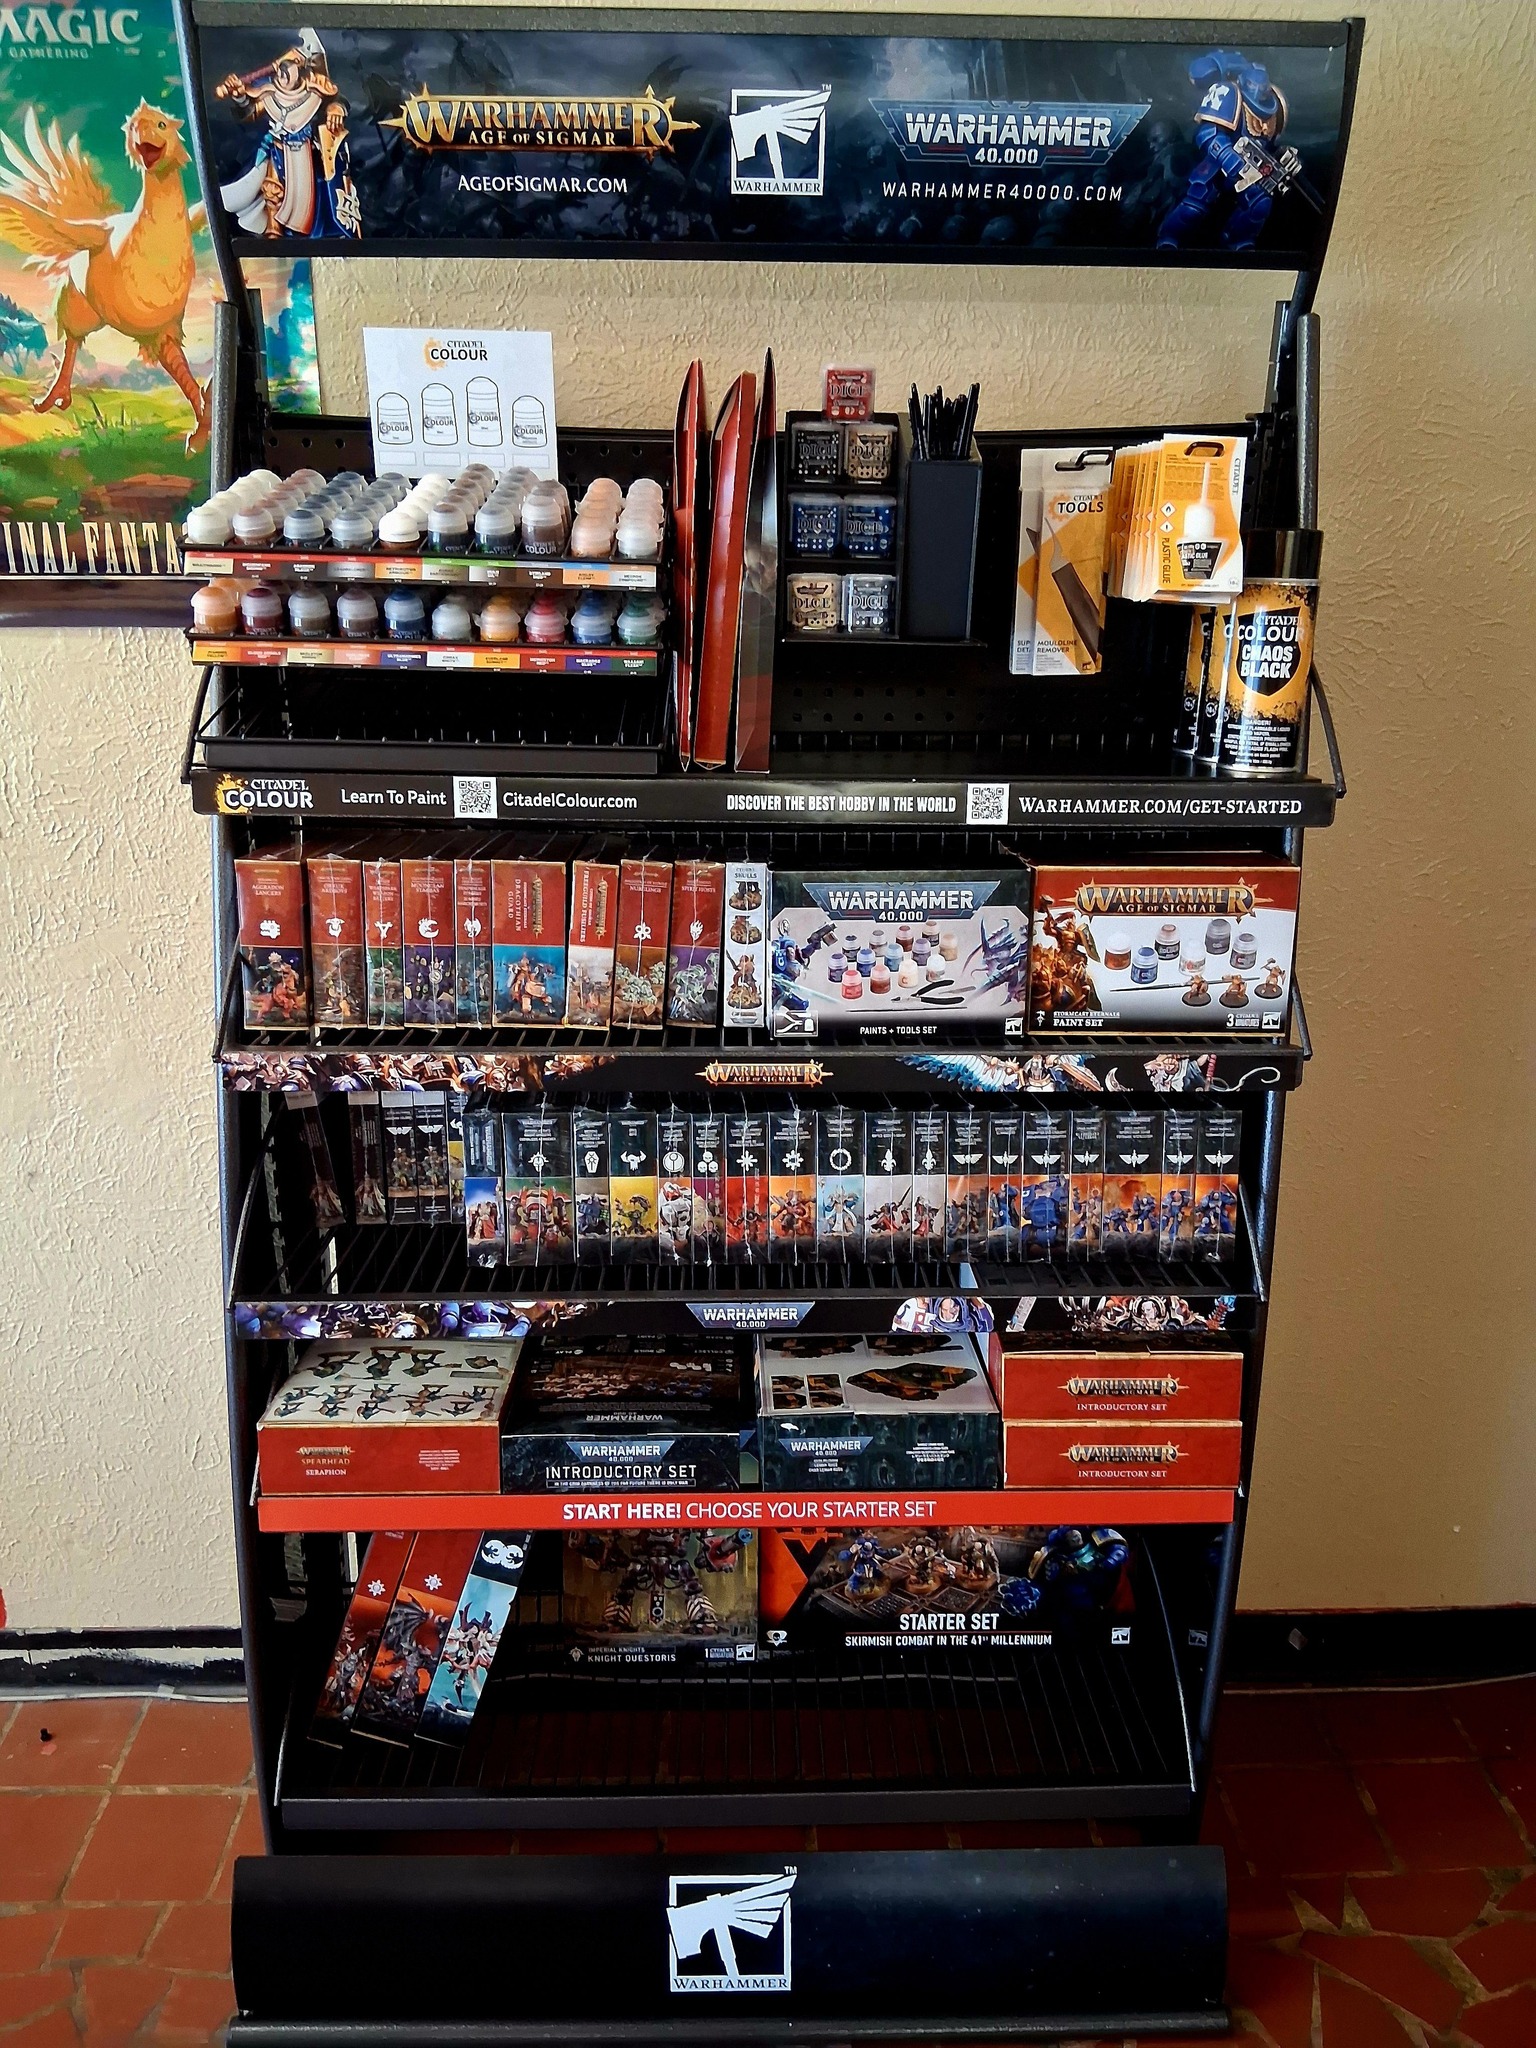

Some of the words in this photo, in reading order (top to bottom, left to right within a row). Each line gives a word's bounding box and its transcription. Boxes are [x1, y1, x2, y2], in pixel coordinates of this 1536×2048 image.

[405, 100, 664, 147] WARHAMMER
[905, 112, 1112, 147] WARHAMMER
[468, 130, 507, 145] AGE
[536, 131, 616, 146] SIGMAR
[733, 179, 821, 194] WARHAMMER
[882, 182, 1123, 202] WARHAMMER40000.COM
[430, 348, 488, 361] COLOUR
[1057, 501, 1105, 514] TOOLS
[81, 521, 189, 575] FANTA
[525, 544, 557, 555] COLOUR
[1161, 537, 1171, 564] PLASTIC
[1162, 564, 1171, 584] GLUE
[793, 597, 832, 611] DICE
[1237, 625, 1304, 643] COLOUR
[1241, 644, 1293, 663] CHAOS
[1240, 661, 1292, 679] BLACK
[250, 779, 309, 791] CITADEL
[225, 789, 314, 809] COLOUR
[341, 788, 384, 804] Learn
[386, 789, 404, 804] To
[407, 789, 447, 806] Paint
[502, 791, 638, 809] CitadelColour.com
[726, 794, 782, 812] DISCOVER
[784, 794, 805, 812] THE
[808, 795, 836, 812] BEST
[839, 796, 875, 813] HOBBY
[878, 796, 890, 813] IN
[893, 796, 914, 813] THE
[916, 796, 957, 814] WORLD
[828, 890, 974, 910] WARHAMMER
[1078, 886, 1249, 914] WARHAMMER
[1117, 904, 1144, 914] AGE
[1162, 904, 1217, 914] SIGMAR
[878, 911, 924, 922] 40,000
[1052, 1018, 1084, 1027] PAINT
[1085, 1018, 1104, 1027] SET
[1226, 1013, 1235, 1027] 3
[859, 1026, 888, 1036] PAINTS
[896, 1025, 922, 1035] TOOLS
[922, 1025, 938, 1035] SET
[708, 1064, 817, 1083] WARHAMMER
[702, 1307, 799, 1321] WARHAMMER
[1069, 1379, 1175, 1396] WARHAMMER
[1077, 1403, 1149, 1411] INTRODUCTORY
[1150, 1403, 1168, 1411] SET
[580, 1445, 661, 1456] WARHAMMER
[790, 1440, 861, 1452] WARHAMMER
[1070, 1446, 1176, 1463] WARHAMMER
[301, 1458, 351, 1466] SPEARHEAD
[305, 1468, 348, 1476] SERAPHON
[545, 1465, 663, 1479] INTRODUCTORY
[668, 1464, 698, 1479] SET
[1078, 1470, 1149, 1478] INTRODUCTORY
[1150, 1470, 1168, 1478] SET
[563, 1503, 620, 1519] START
[627, 1503, 682, 1519] HERE!
[686, 1502, 763, 1519] CHOOSE
[766, 1502, 818, 1518] YOUR
[823, 1501, 901, 1518] STARTER
[904, 1501, 938, 1517] SET
[899, 1613, 967, 1631] STARTER
[970, 1612, 1000, 1630] SET
[845, 1635, 893, 1647] SKIRMISH
[895, 1635, 935, 1646] COMBAT
[936, 1635, 948, 1646] IN
[950, 1635, 968, 1646] THE
[991, 1634, 1053, 1646] MILLENNIUM
[587, 1653, 622, 1663] KNIGHT
[625, 1653, 677, 1663] QUESTORIS
[704, 1647, 709, 1659] 1
[784, 1866, 798, 1874] TM
[672, 1977, 789, 1990] WARHAMMER
